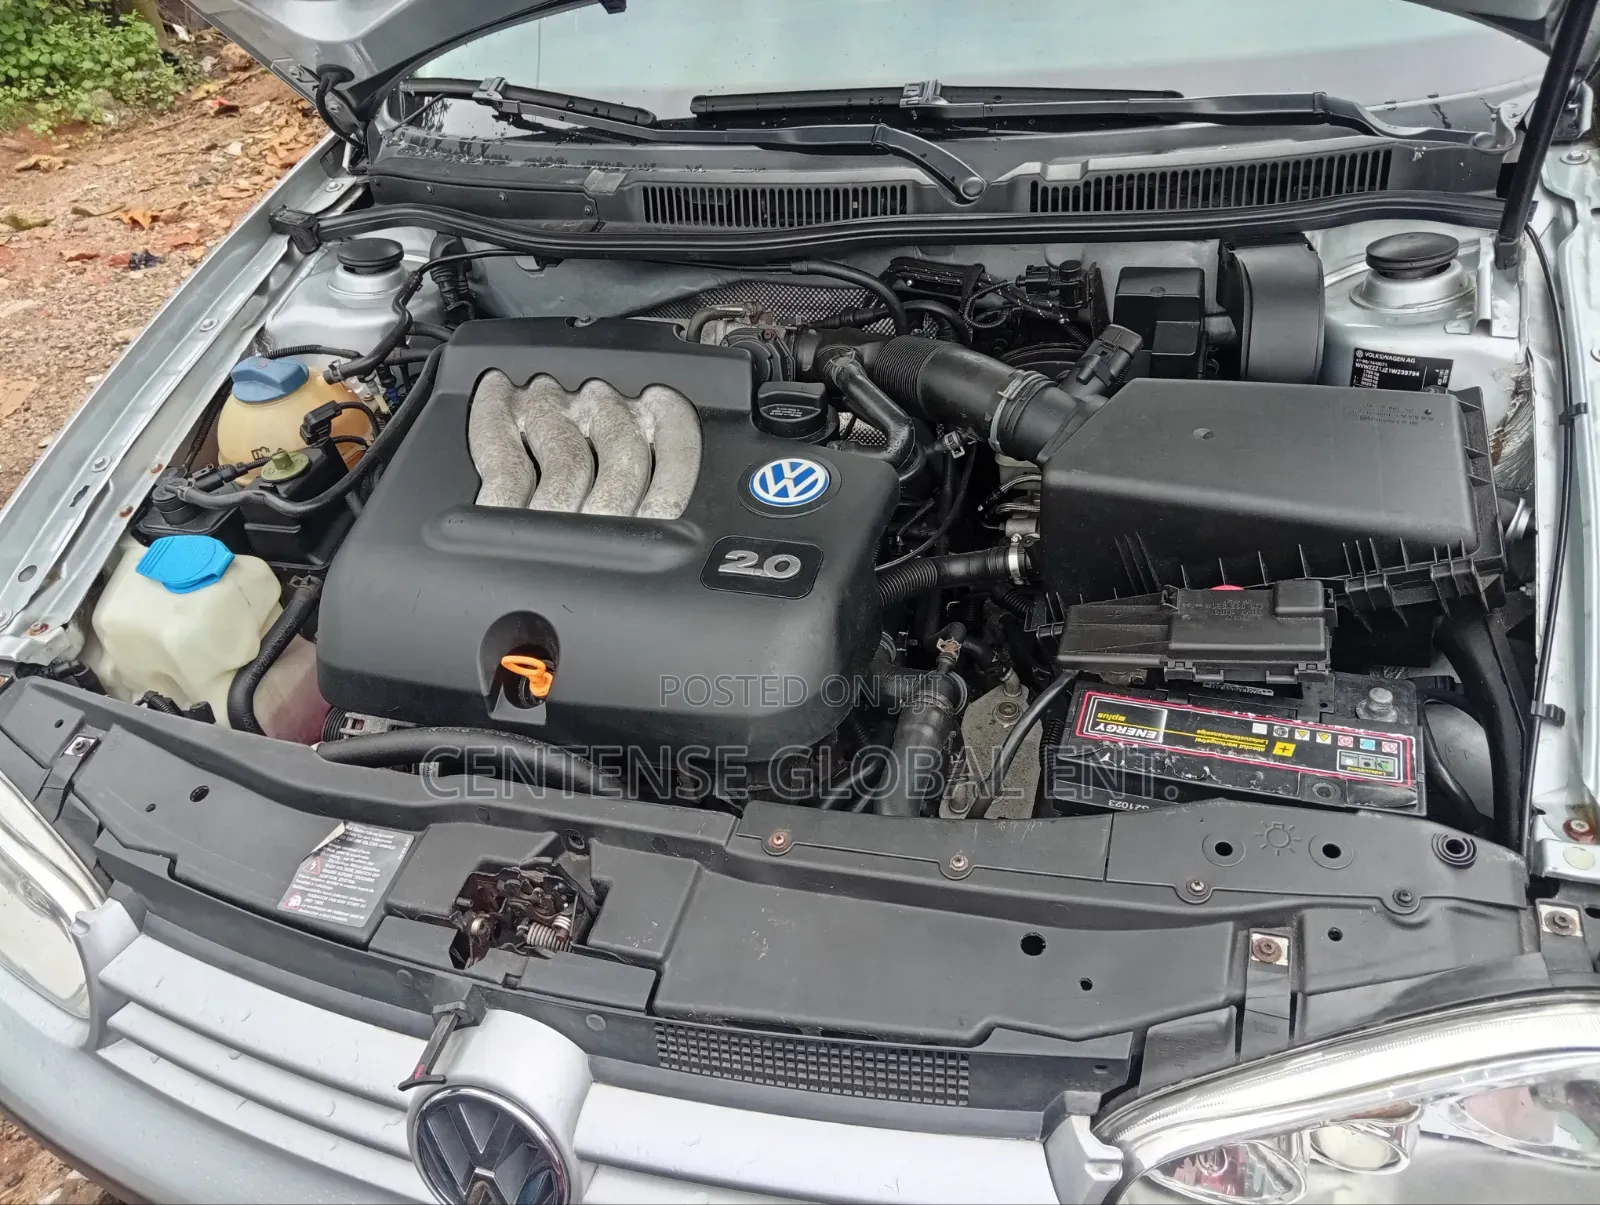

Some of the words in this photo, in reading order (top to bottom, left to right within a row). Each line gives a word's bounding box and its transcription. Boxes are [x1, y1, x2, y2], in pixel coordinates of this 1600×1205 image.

[1365, 352, 1405, 362] VOLKSWAGEN
[718, 549, 802, 579] 2.0
[1094, 723, 1158, 739] ENERGY
